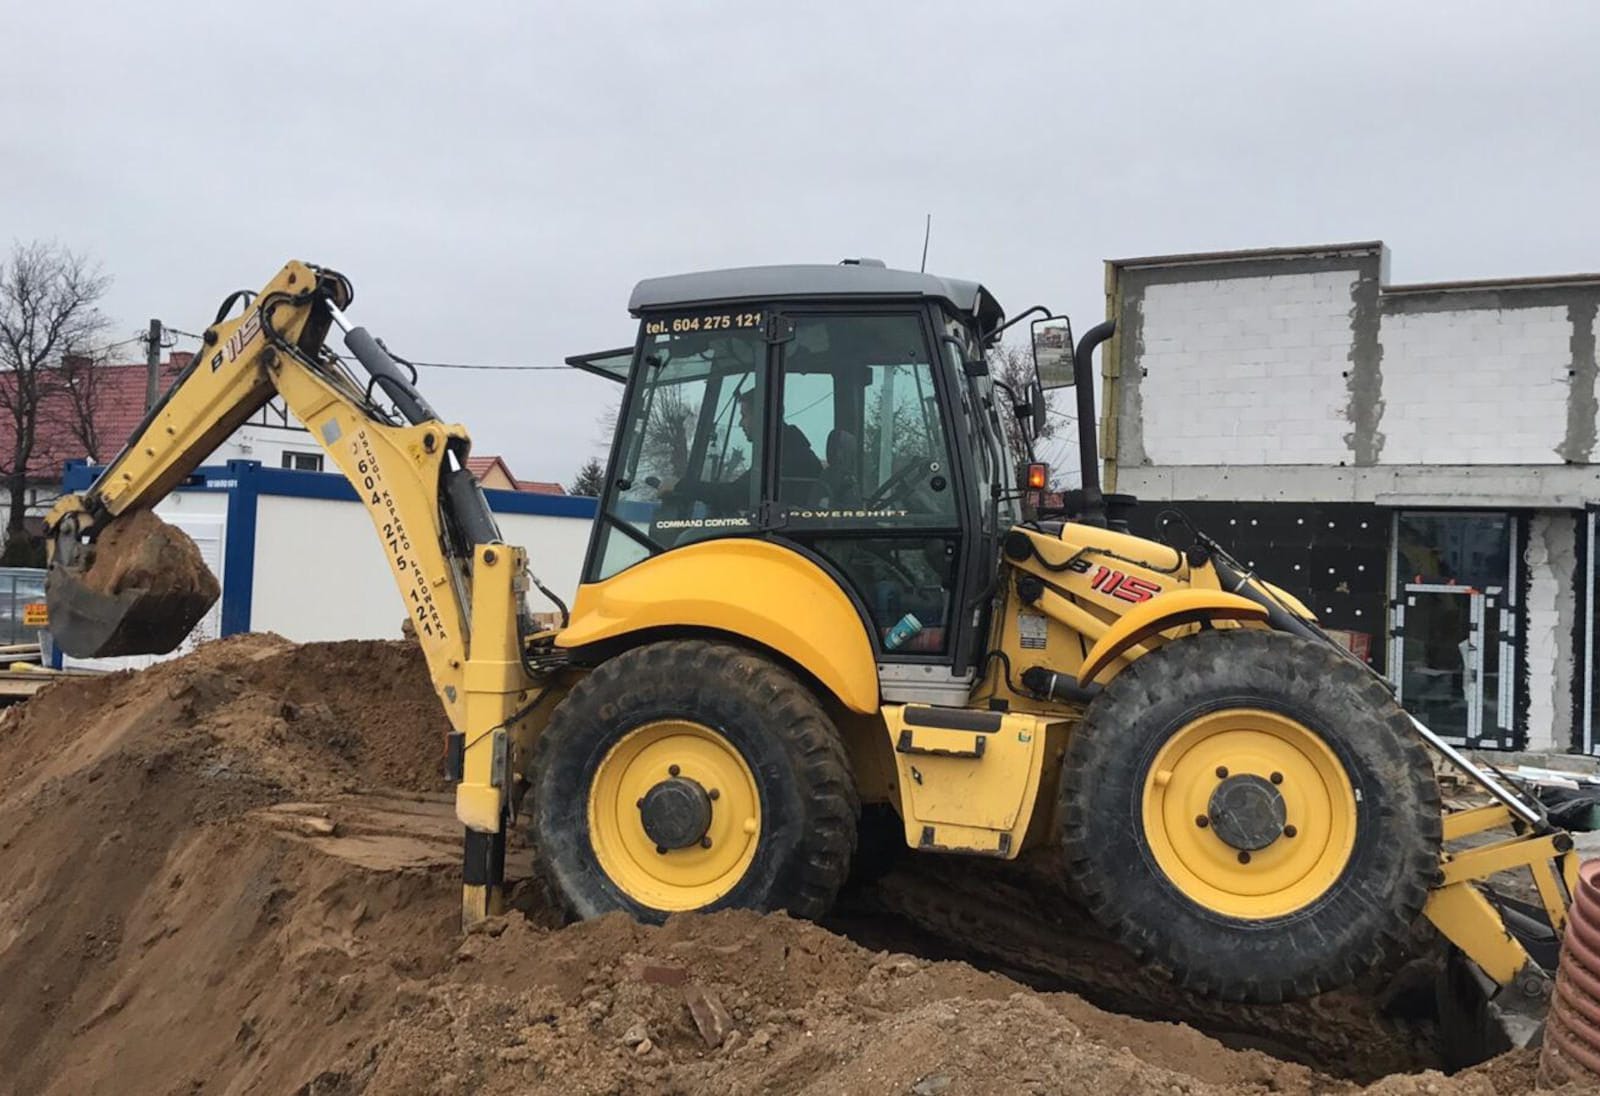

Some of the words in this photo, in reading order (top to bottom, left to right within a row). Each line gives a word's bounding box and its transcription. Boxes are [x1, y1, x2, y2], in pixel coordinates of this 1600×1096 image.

[646, 321, 669, 334] tel.
[673, 318, 700, 332] 604
[703, 315, 731, 330] 275
[736, 313, 761, 327] 121
[211, 349, 224, 373] B
[656, 519, 703, 529] COMMAND
[704, 517, 751, 527] CONTROL
[358, 460, 381, 505] 604
[383, 523, 407, 571] 275
[410, 589, 433, 636] 121
[1069, 559, 1093, 574] B
[1091, 566, 1162, 603] 115
